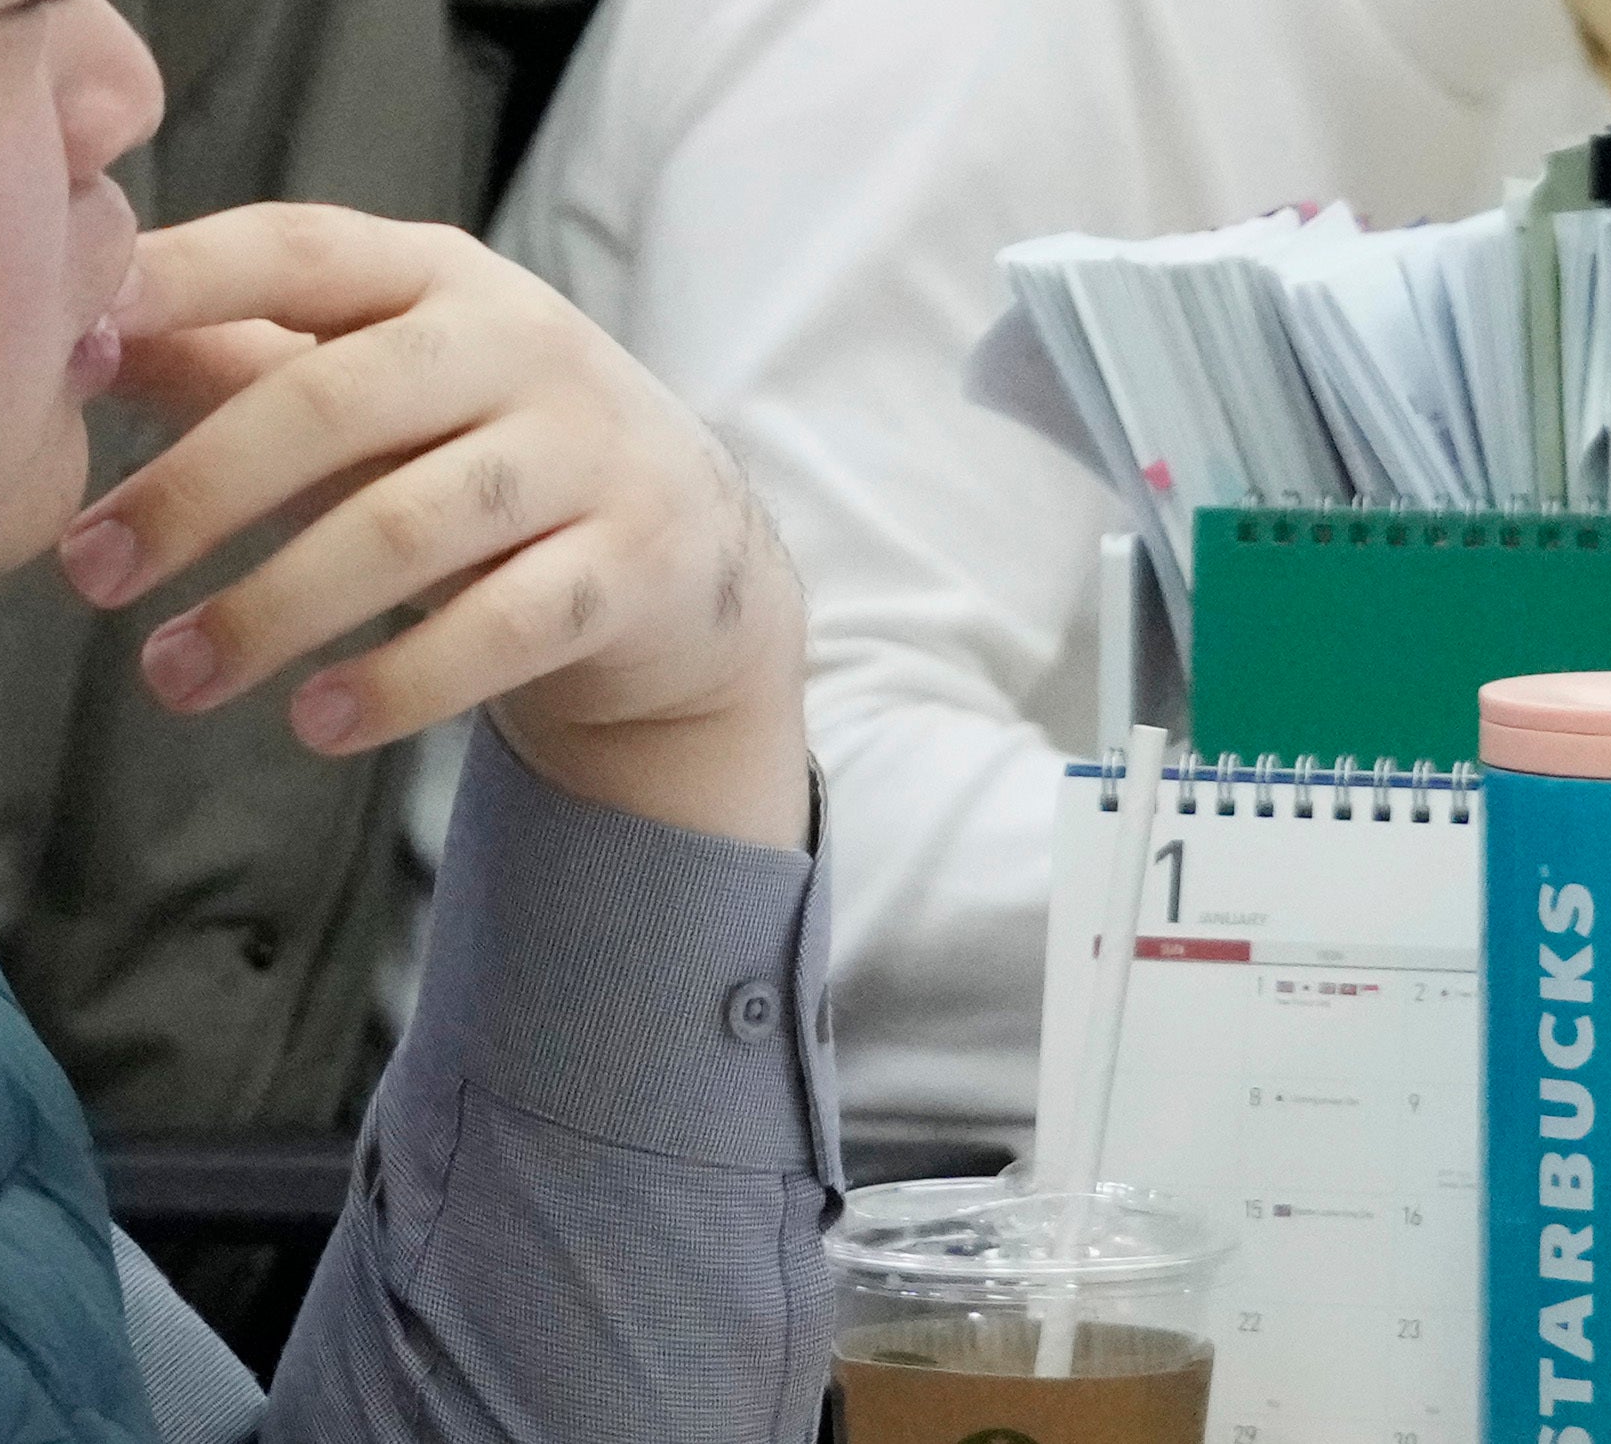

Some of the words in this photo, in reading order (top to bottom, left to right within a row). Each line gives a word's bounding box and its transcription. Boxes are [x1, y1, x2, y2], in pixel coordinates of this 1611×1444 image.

[1156, 839, 1184, 923] 1
[1413, 984, 1425, 1001] 2
[1249, 1087, 1262, 1106] 8
[1409, 1093, 1420, 1112] 9
[1244, 1199, 1263, 1220] 15
[1403, 1206, 1423, 1226] 16
[1238, 1313, 1262, 1332] 22
[1397, 1319, 1421, 1339] 23
